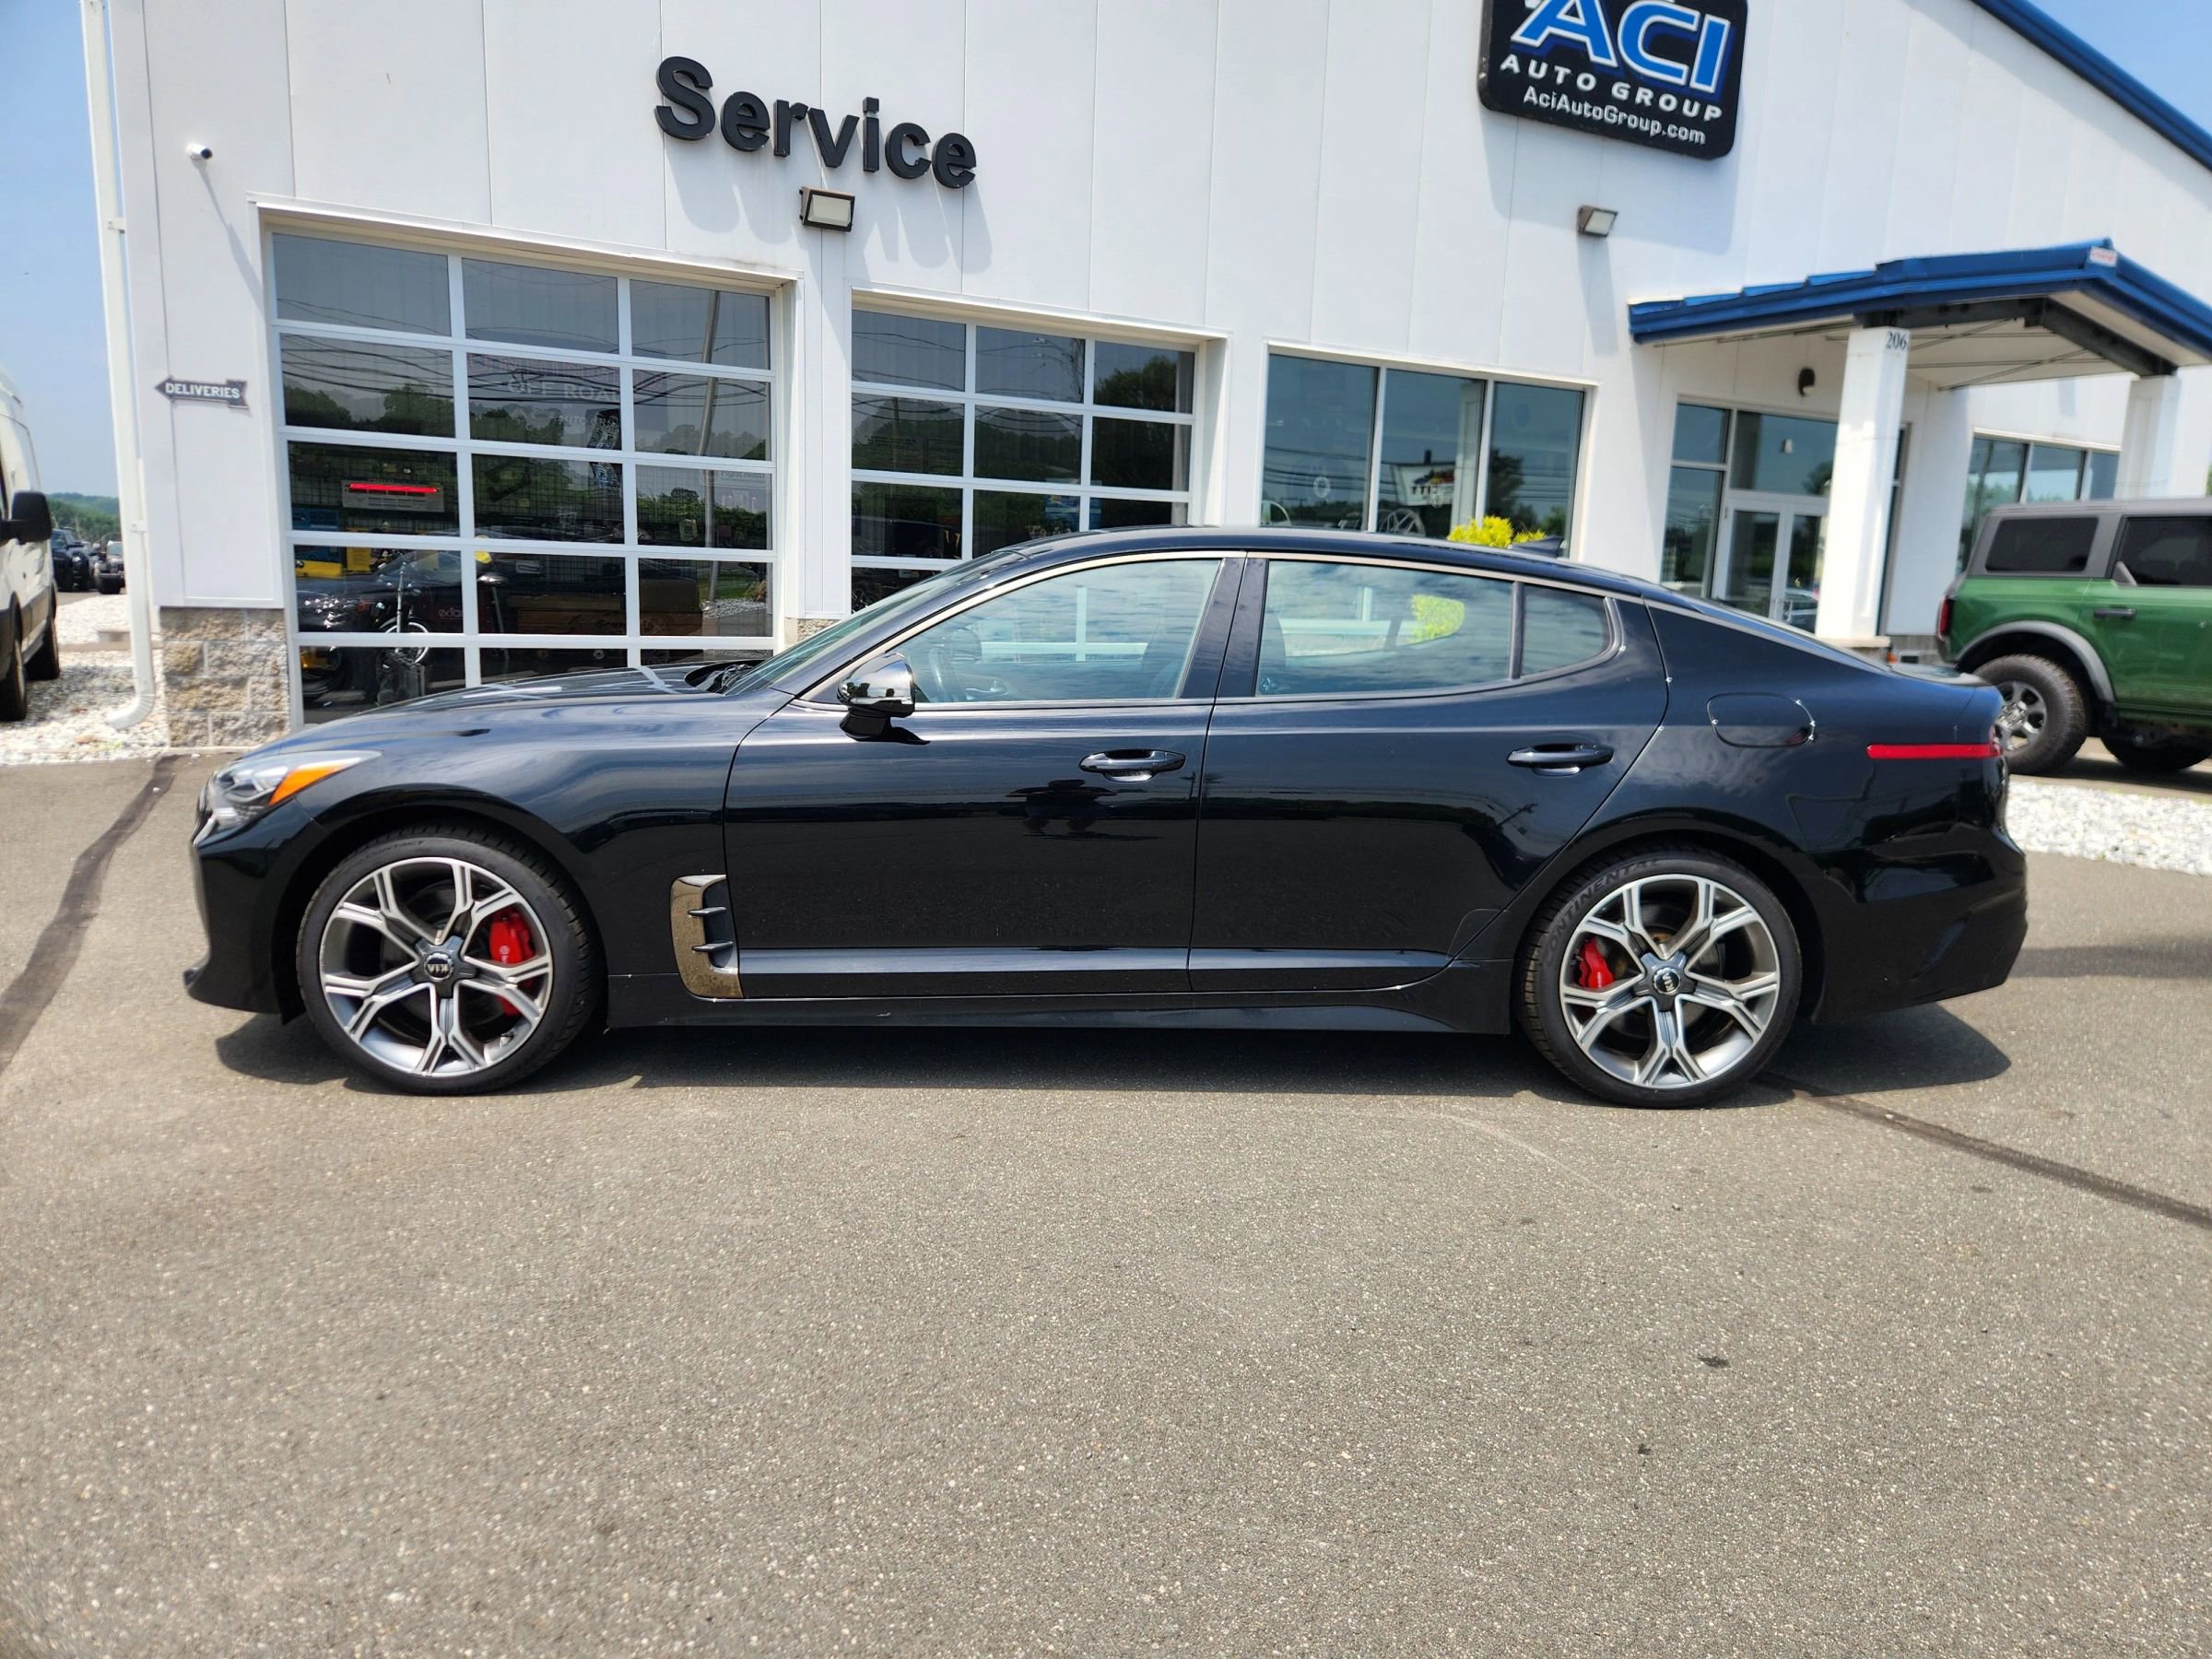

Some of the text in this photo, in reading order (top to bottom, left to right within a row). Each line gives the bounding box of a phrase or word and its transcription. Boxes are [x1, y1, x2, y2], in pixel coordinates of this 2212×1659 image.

[1510, 0, 1731, 94] ACI
[1500, 53, 1724, 122] AUTO GROUP
[1523, 85, 1707, 146] AciAutoGroup.com
[653, 55, 977, 190] Service
[1886, 330, 1908, 351] 206
[165, 382, 241, 399] DELIVERIES
